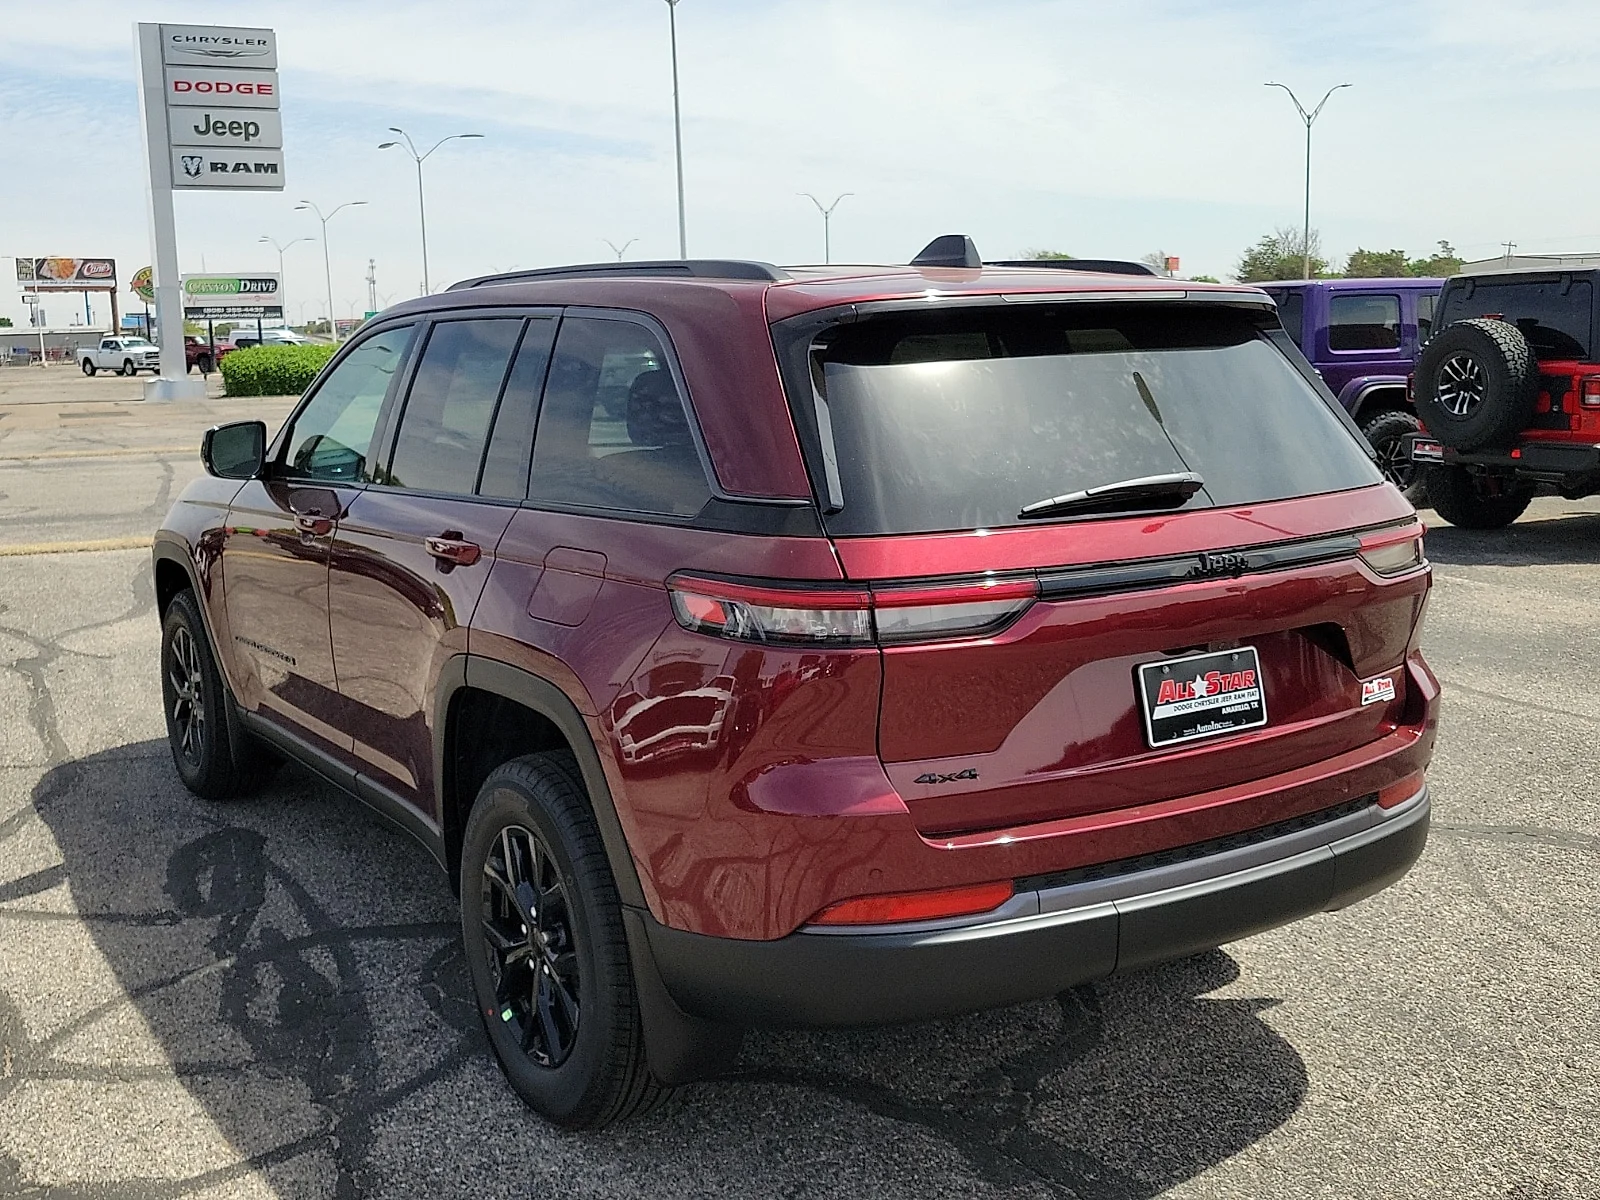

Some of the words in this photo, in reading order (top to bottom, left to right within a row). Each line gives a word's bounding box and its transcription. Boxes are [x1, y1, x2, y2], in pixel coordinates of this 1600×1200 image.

[172, 35, 268, 46] CHRYSLER
[173, 81, 273, 95] DODGE
[193, 113, 260, 141] Jeep
[209, 162, 279, 174] RAM
[188, 282, 236, 293] CANYON
[239, 280, 276, 292] DRIVE
[1157, 680, 1195, 704] ALL
[1204, 670, 1255, 696] STAR
[1173, 702, 1193, 712] DODGE
[1194, 697, 1220, 708] CHRYSLER
[1220, 695, 1233, 703] JEEP
[1247, 690, 1258, 699] FIAT
